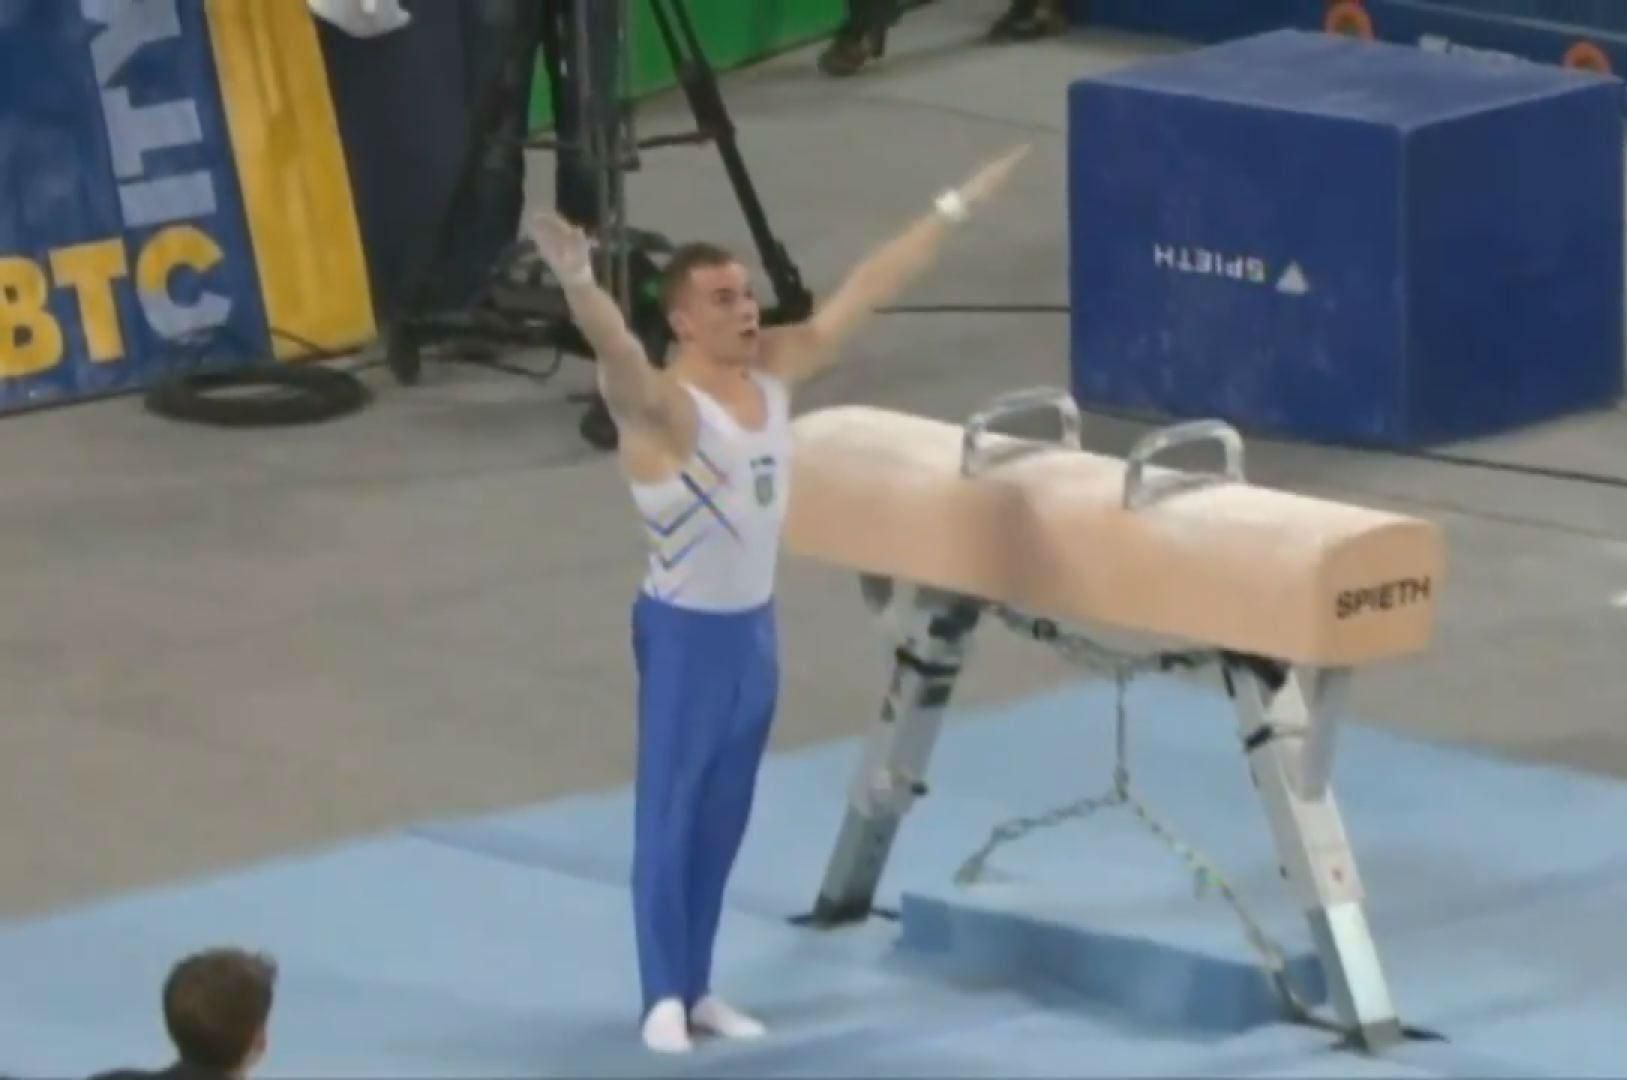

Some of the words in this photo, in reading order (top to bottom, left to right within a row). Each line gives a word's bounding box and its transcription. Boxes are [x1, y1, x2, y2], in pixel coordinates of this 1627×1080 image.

[1154, 243, 1265, 283] SPIETH
[0, 225, 231, 376] BTC
[1336, 576, 1430, 619] SPIETH
